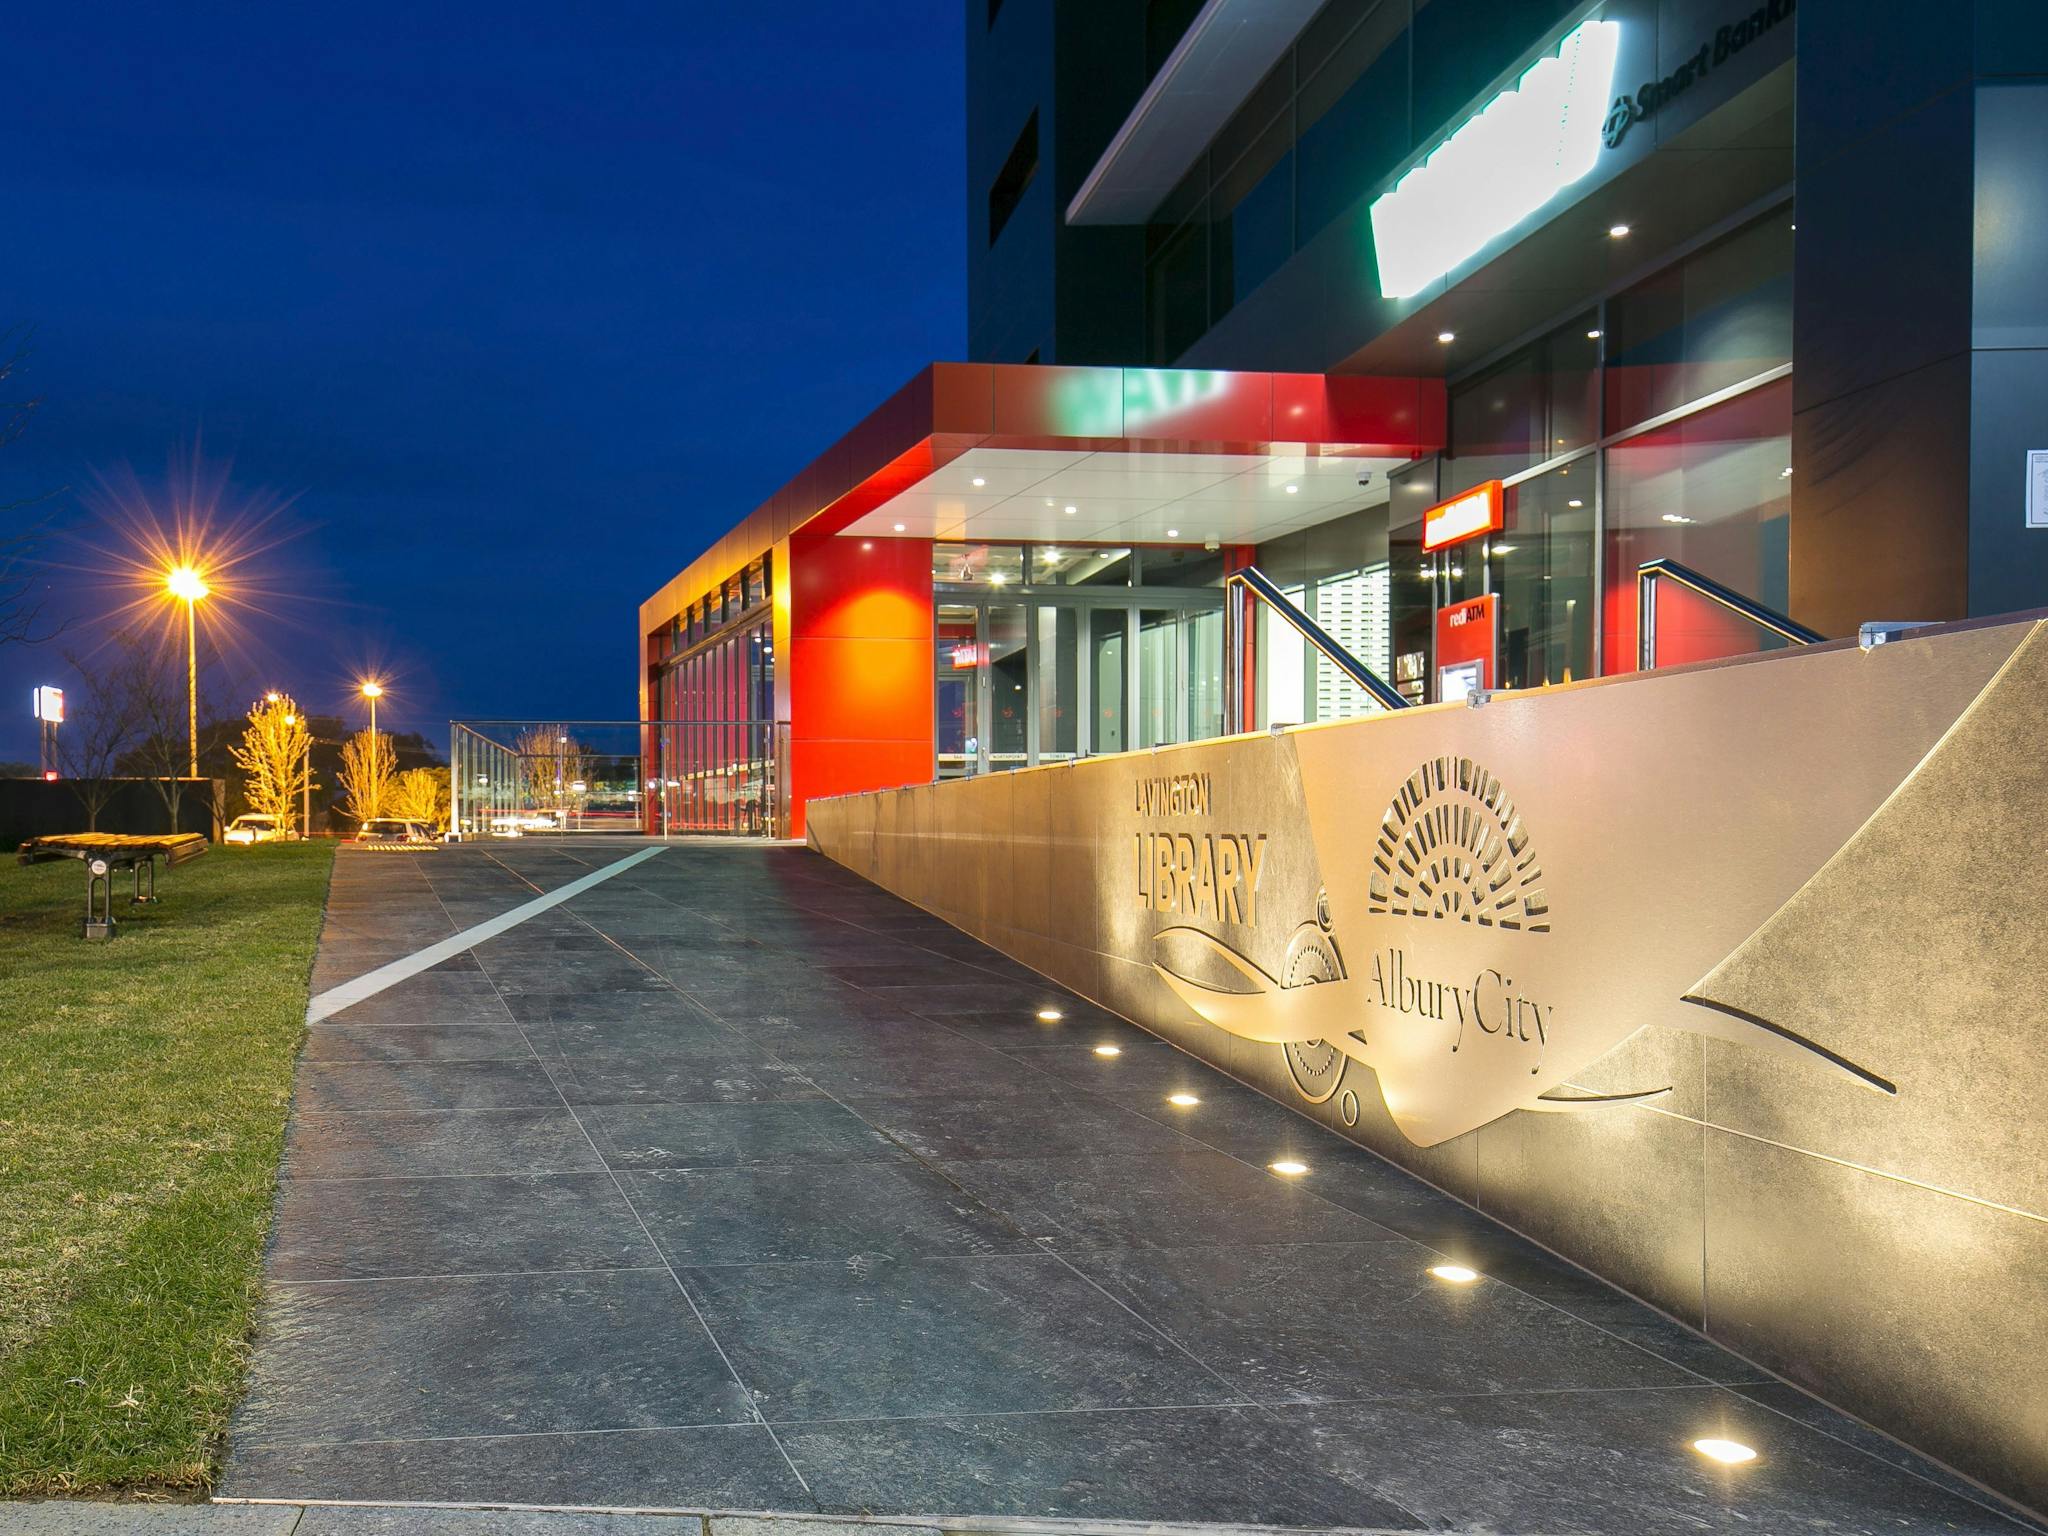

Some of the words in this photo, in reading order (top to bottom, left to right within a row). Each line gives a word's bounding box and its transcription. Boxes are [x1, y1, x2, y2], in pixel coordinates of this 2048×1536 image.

[1634, 43, 1708, 121] Smart
[1712, 0, 1796, 67] Banki
[1135, 772, 1212, 817] LAVINGTON
[1133, 832, 1267, 929] LIBRARY
[1367, 948, 1554, 1075] AlburyCity
